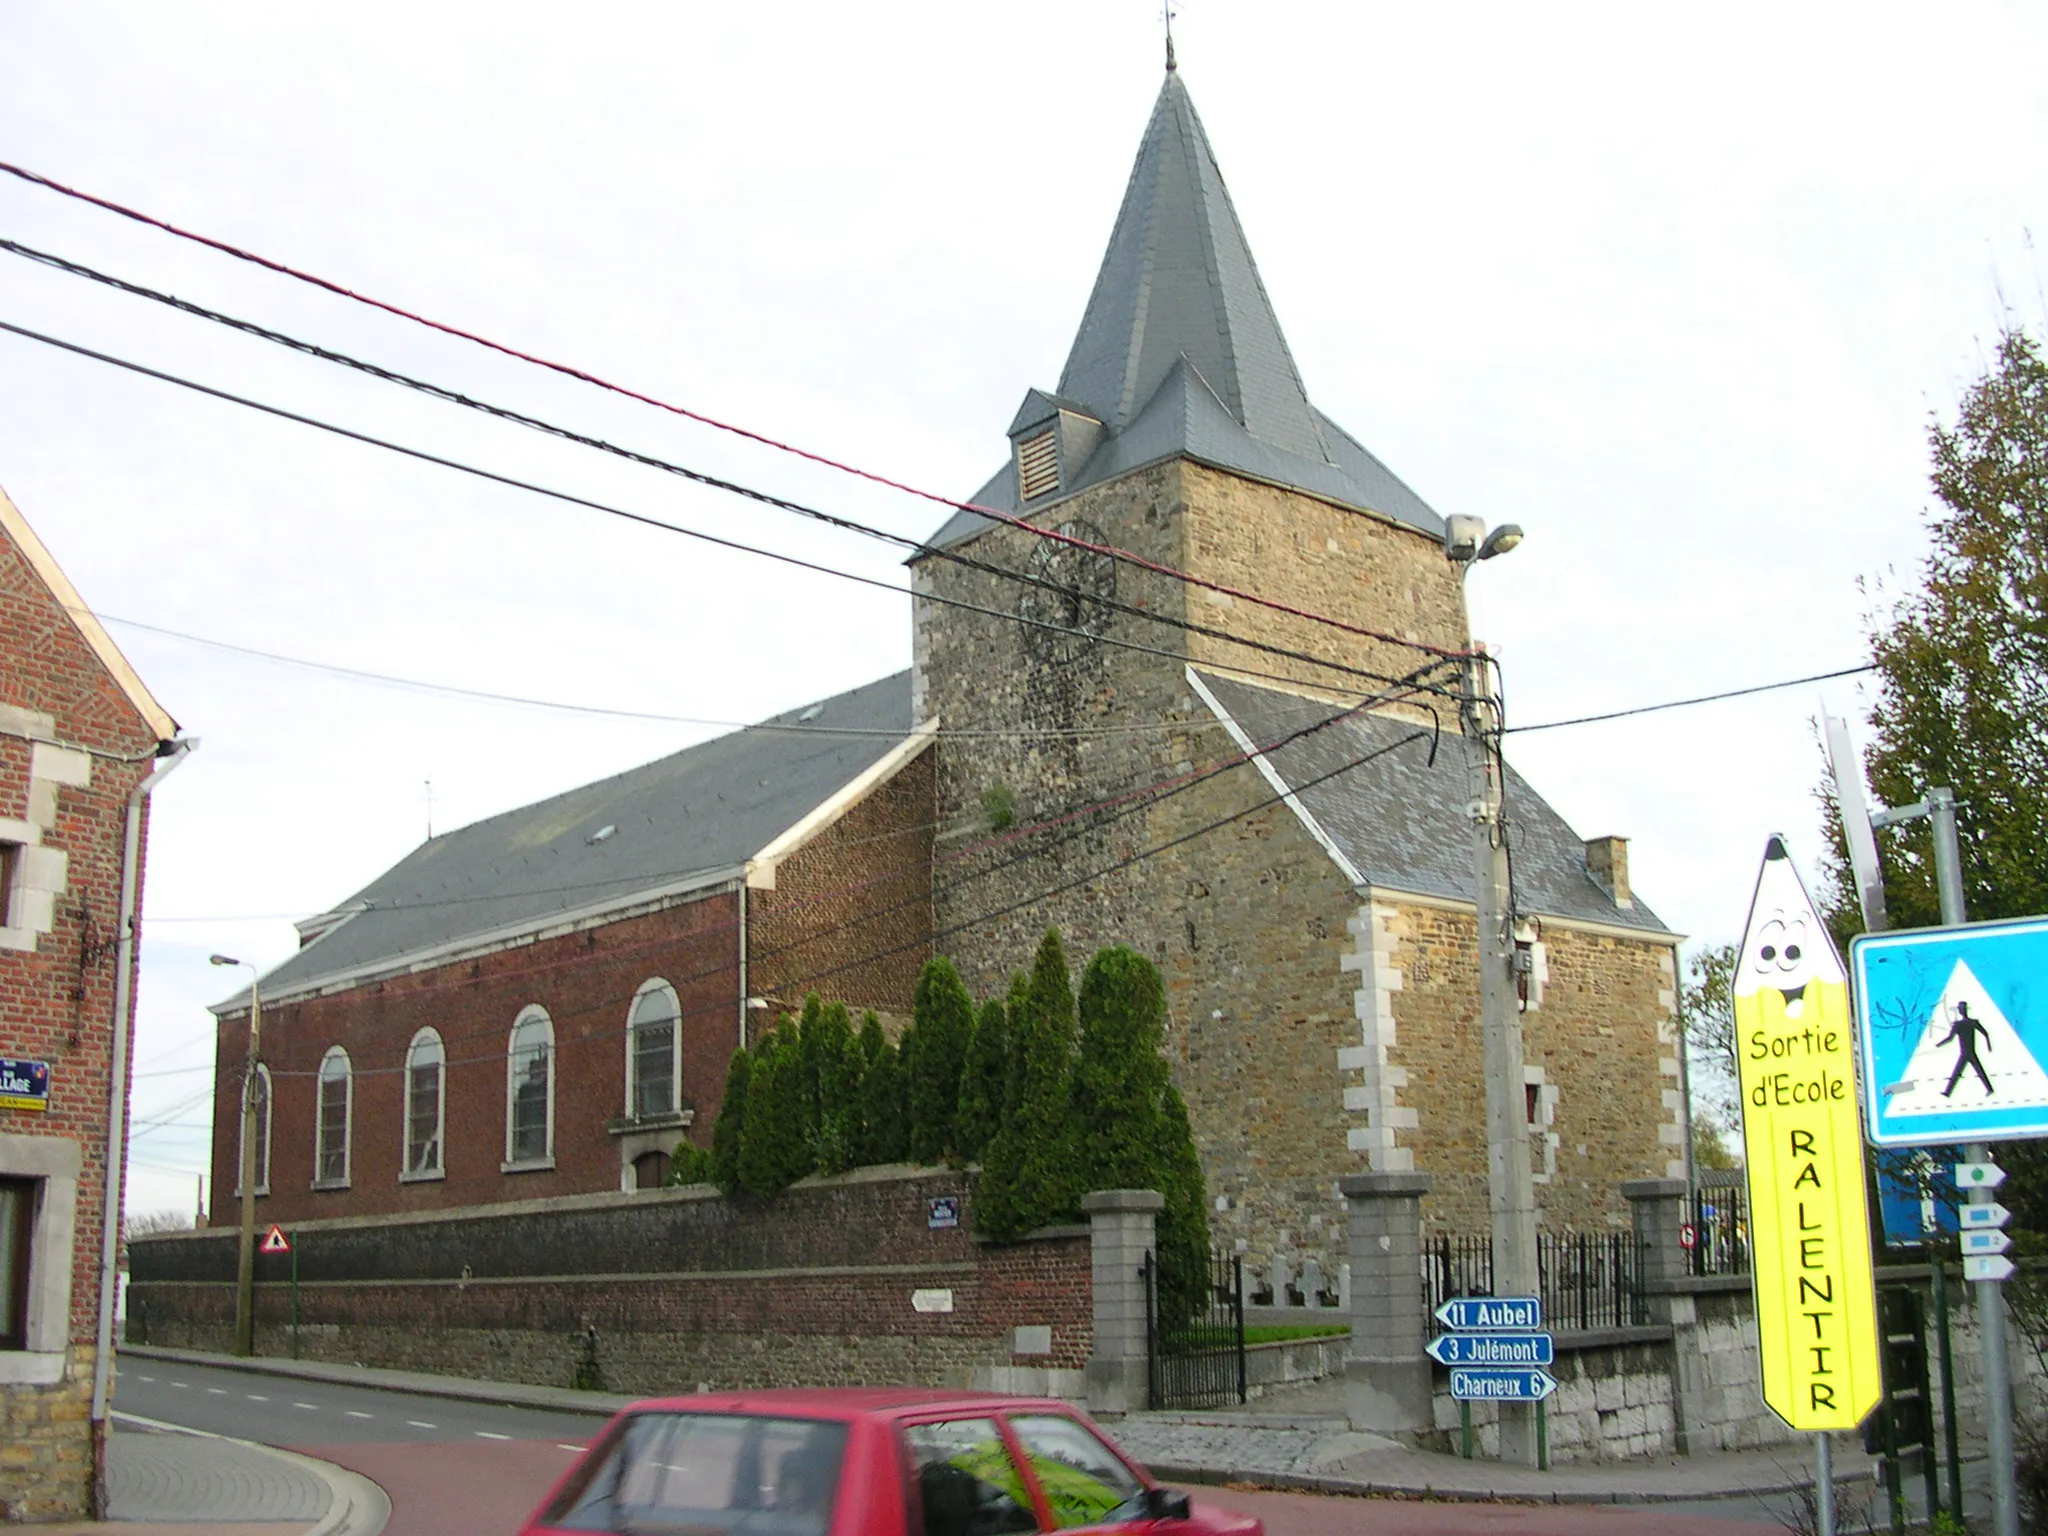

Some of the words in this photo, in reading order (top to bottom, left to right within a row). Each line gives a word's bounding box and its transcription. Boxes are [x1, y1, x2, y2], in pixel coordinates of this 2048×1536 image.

[1750, 1022, 1840, 1060] Sortie
[1751, 1072, 1845, 1109] d'Ecole
[1791, 1129, 1838, 1412] RALENTIR
[1451, 1303, 1466, 1325] 11
[1478, 1303, 1533, 1325] Aubel
[1449, 1339, 1459, 1361] 3
[1467, 1339, 1540, 1361] Julémont
[1453, 1374, 1521, 1396] Charneux
[1530, 1375, 1541, 1396] 6
